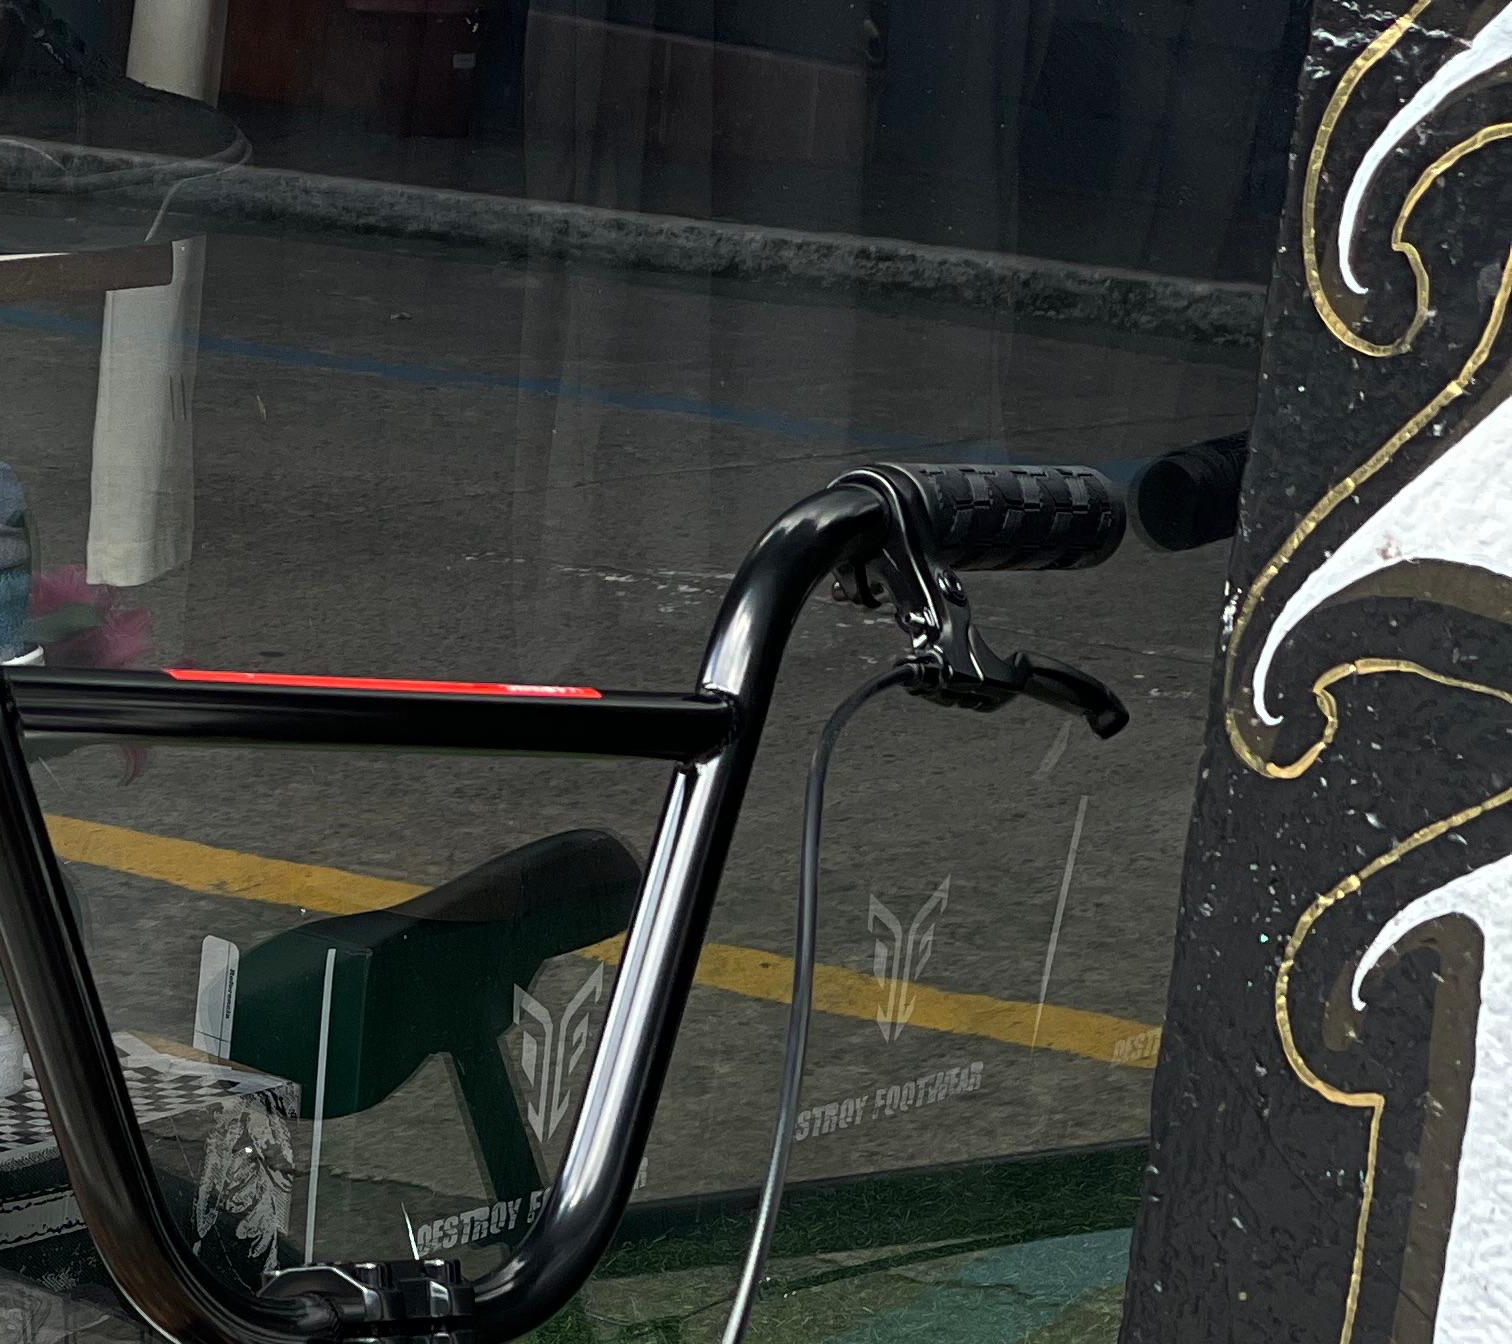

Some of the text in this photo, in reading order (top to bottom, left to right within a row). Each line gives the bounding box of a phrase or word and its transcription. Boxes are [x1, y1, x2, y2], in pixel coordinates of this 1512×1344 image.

[794, 1061, 984, 1142] STROY FOOTWEAR
[416, 1197, 523, 1257] DESTROY
